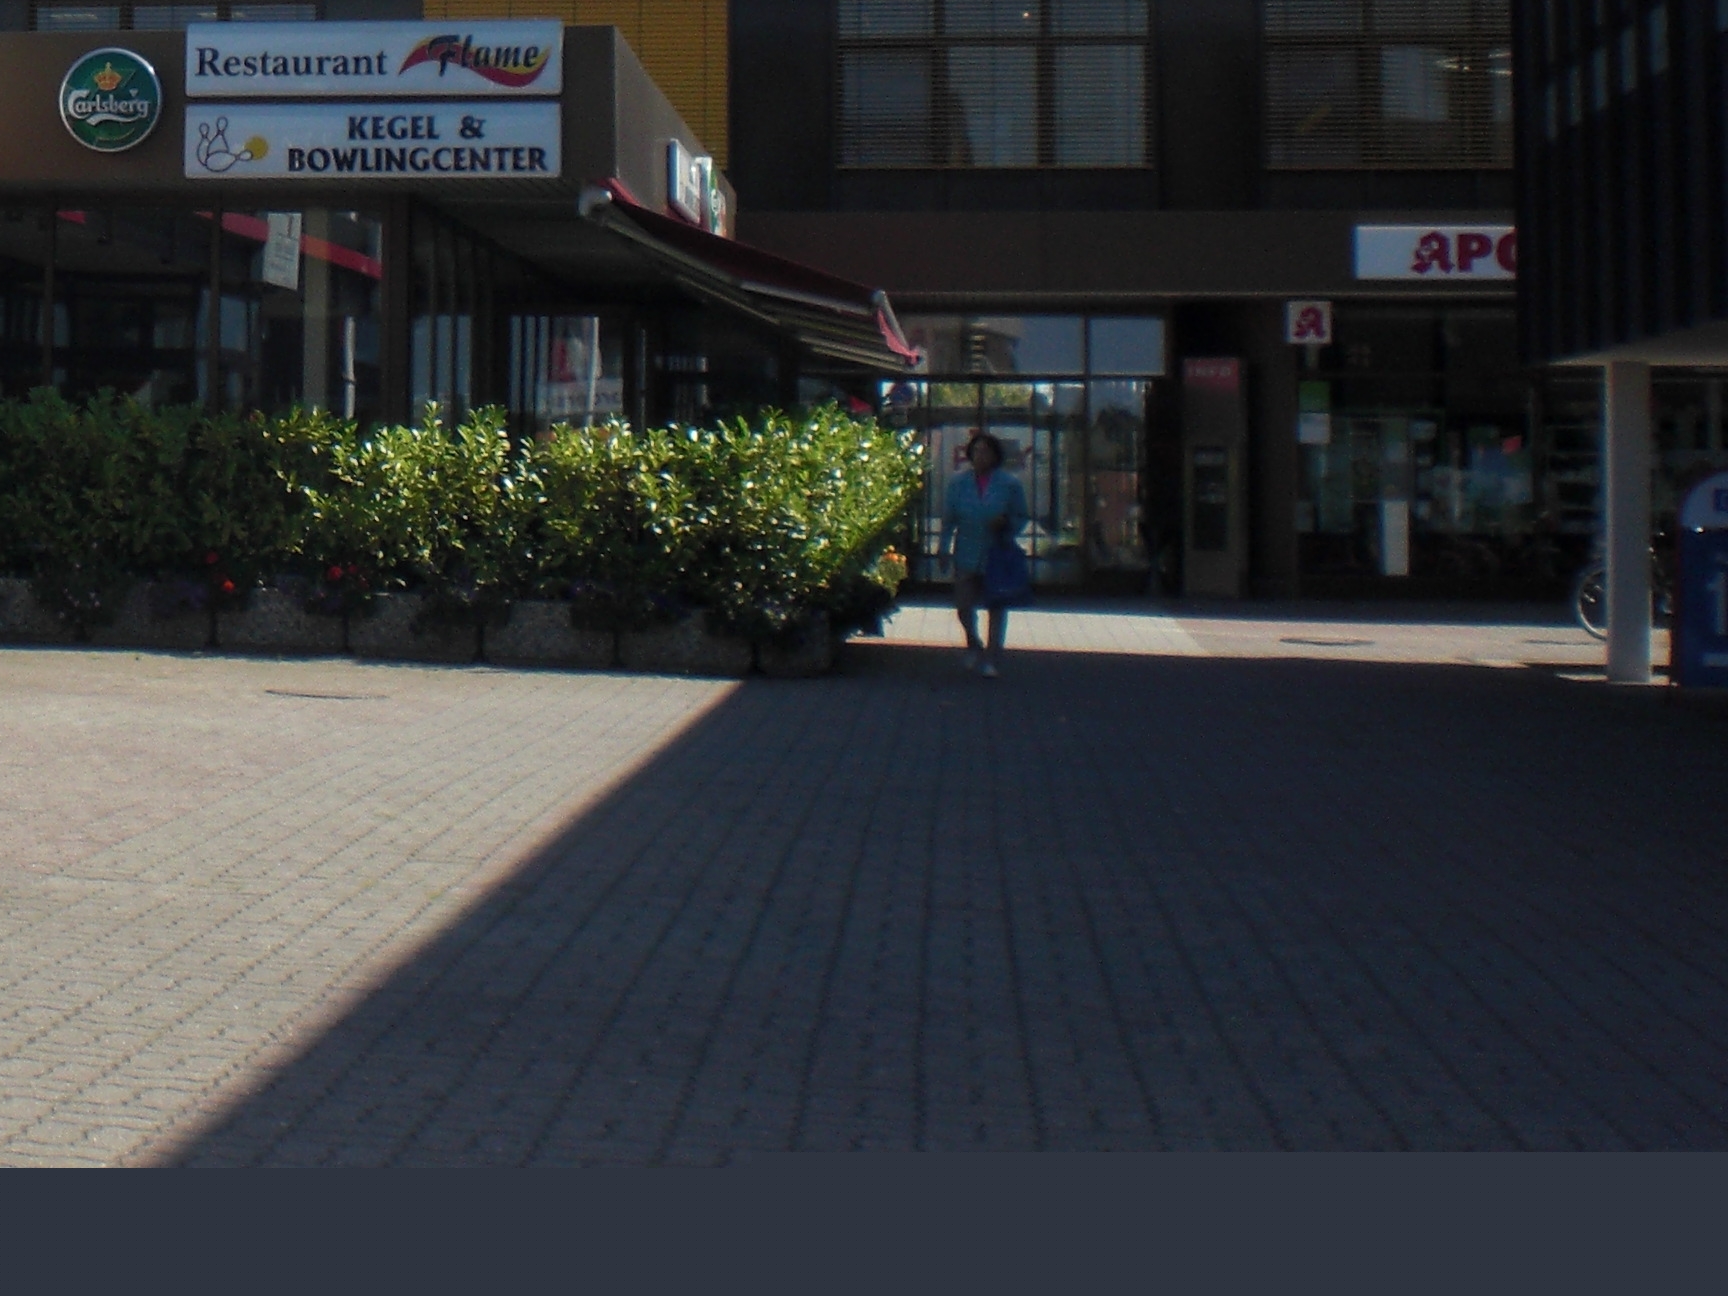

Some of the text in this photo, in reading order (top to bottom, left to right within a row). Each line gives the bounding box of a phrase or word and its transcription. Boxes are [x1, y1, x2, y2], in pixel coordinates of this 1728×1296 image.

[194, 34, 540, 77] Restaurant Flame
[68, 89, 151, 123] Carlsberg
[348, 115, 485, 140] KEGEL &
[287, 147, 547, 172] BOWLINGCENTER
